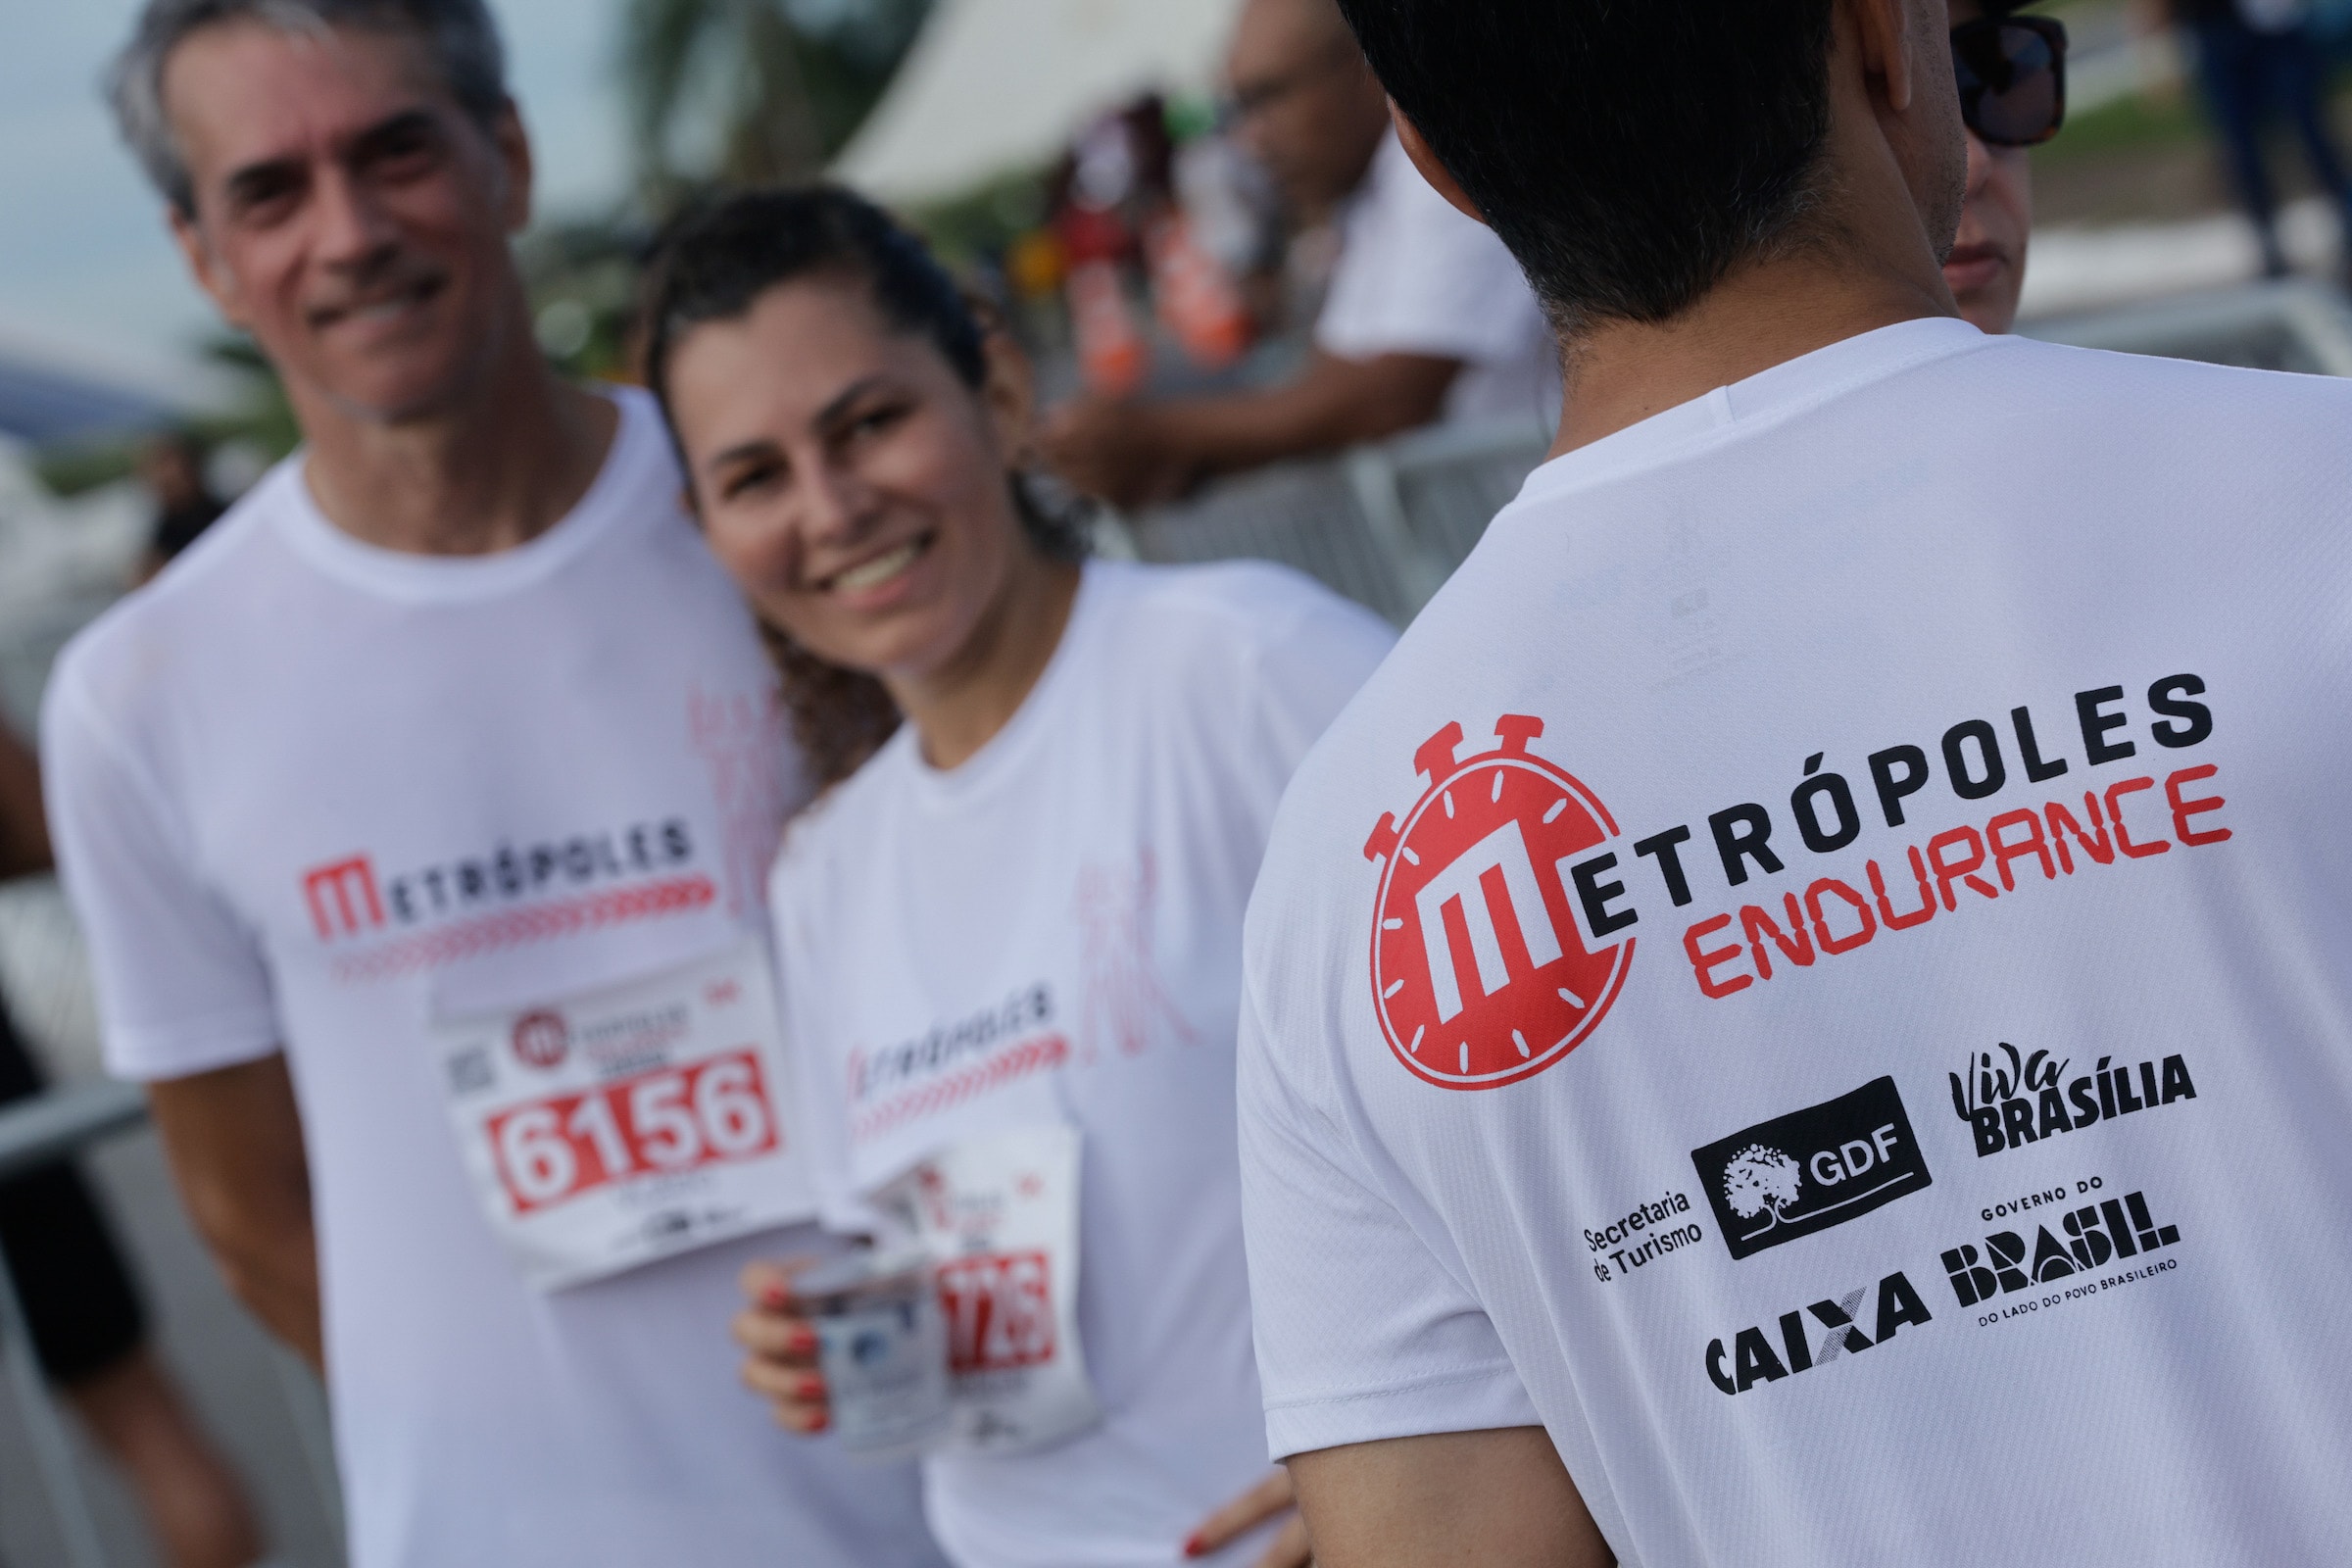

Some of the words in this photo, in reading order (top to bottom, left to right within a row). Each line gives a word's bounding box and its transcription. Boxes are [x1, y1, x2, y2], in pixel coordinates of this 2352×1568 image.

[303, 817, 694, 943] METRÓPOLES
[1413, 673, 2213, 1027] METRÓPOLES
[1683, 762, 2231, 1000] ENDURANCE
[497, 1058, 767, 1201] 6156
[1948, 1042, 2070, 1121] Viva
[1971, 1054, 2197, 1157] BRASÍLIA
[1809, 1122, 1900, 1188] GDF
[1981, 1187, 2066, 1221] GOVERNO
[2077, 1176, 2103, 1194] DO
[1584, 1191, 1690, 1252] Secretaria
[1593, 1258, 1612, 1283] de
[1608, 1224, 1702, 1274] Turismo
[1939, 1191, 2181, 1308] BRASIL
[1705, 1271, 1933, 1396] CAIXA
[1979, 1313, 1998, 1327] DO
[2002, 1300, 2038, 1319] LADO
[2042, 1295, 2061, 1307] DO
[2065, 1284, 2097, 1300] POVO
[2101, 1258, 2178, 1290] BRASILEIRO
